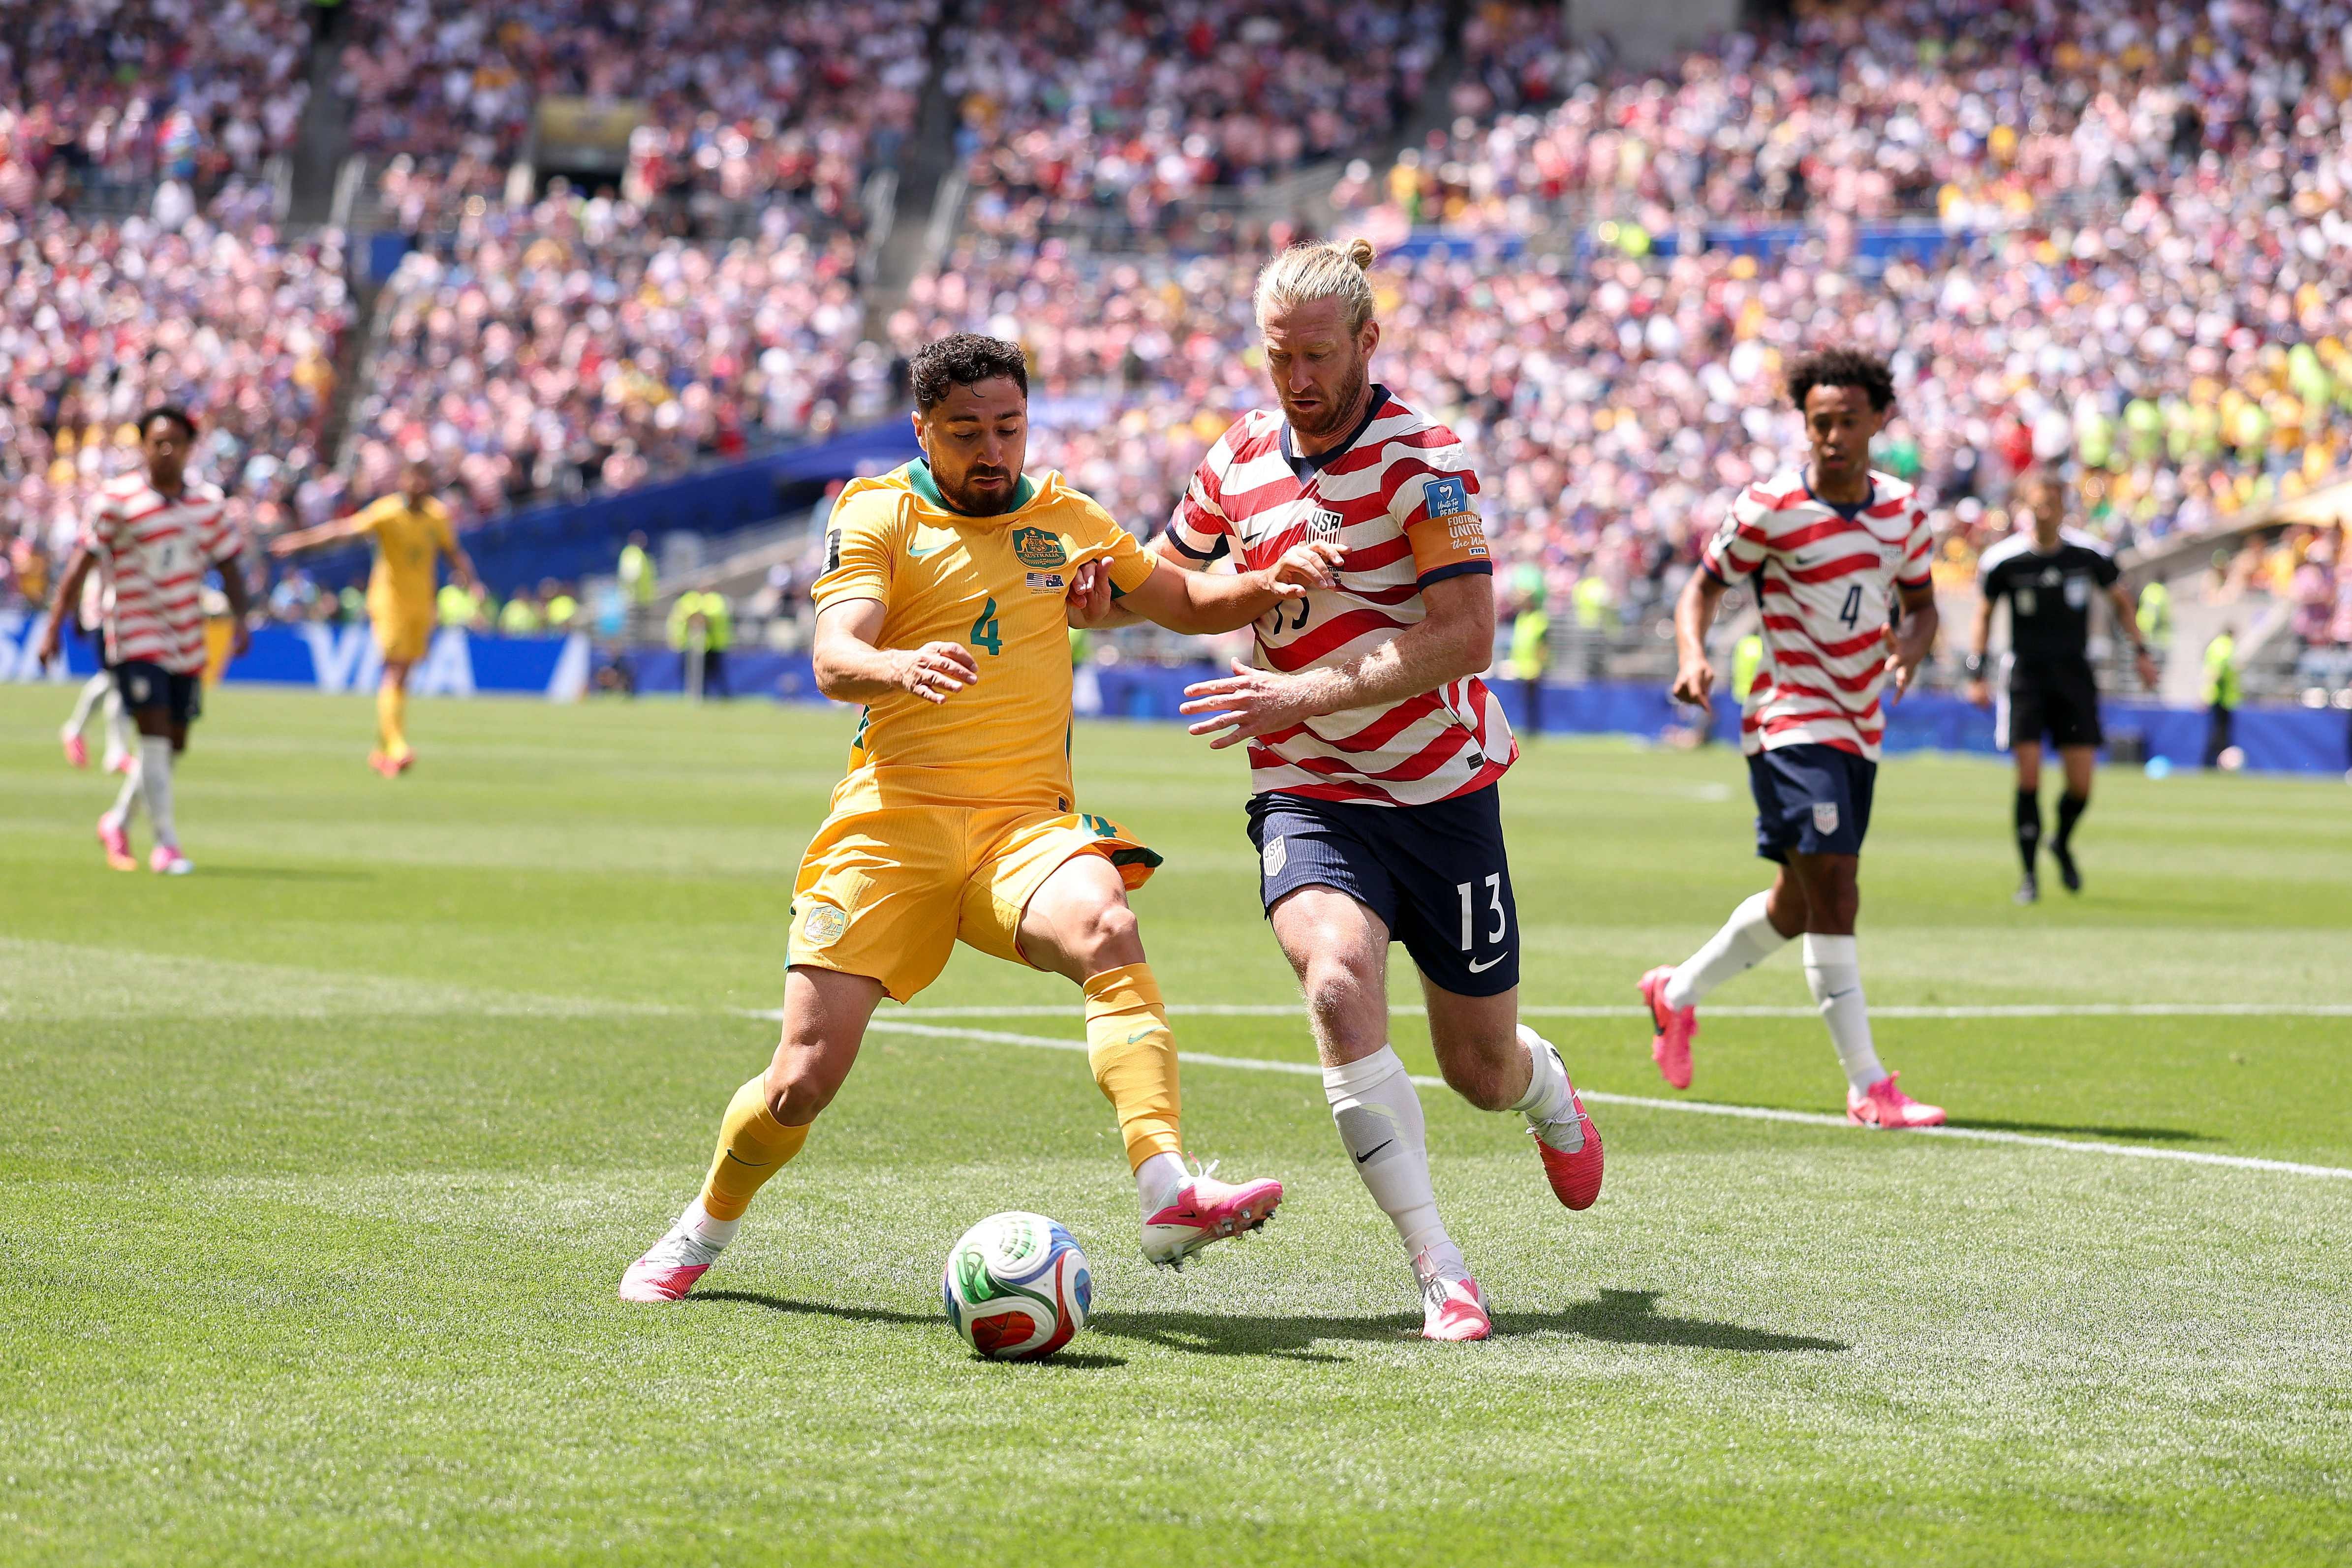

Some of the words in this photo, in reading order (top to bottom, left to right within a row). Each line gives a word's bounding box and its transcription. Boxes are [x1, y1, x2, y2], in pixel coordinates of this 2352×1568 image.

[1312, 511, 1340, 532] USA
[1448, 515, 1481, 526] FOOTBALL
[1449, 523, 1483, 538] UNITE
[1451, 538, 1469, 550] the
[1840, 585, 1862, 631] 4
[970, 597, 1003, 656] 4
[1265, 838, 1282, 859] USA
[1456, 872, 1506, 952] 13
